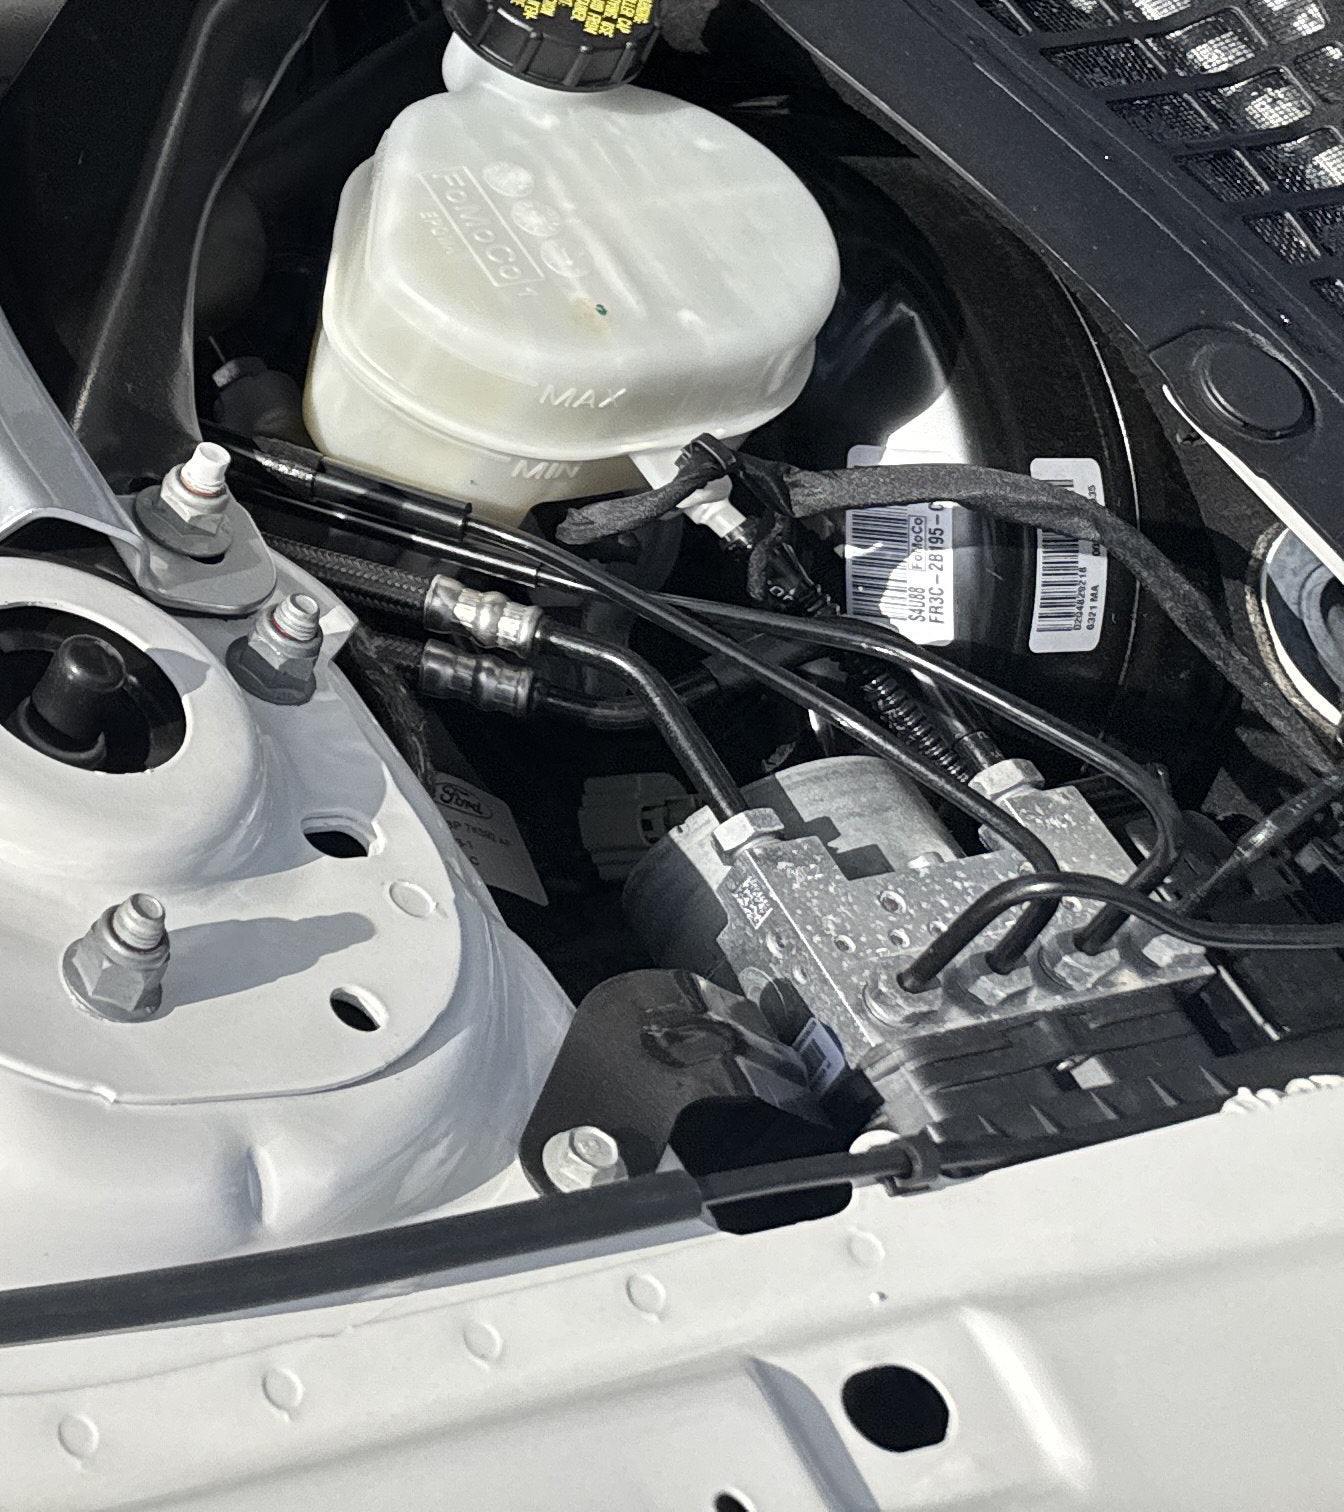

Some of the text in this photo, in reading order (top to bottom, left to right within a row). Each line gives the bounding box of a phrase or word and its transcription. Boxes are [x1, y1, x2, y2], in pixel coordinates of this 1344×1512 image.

[432, 173, 522, 280] FoMoCo
[539, 384, 627, 408] MAX
[512, 459, 583, 480] MIN
[908, 517, 926, 623] S4U88 FoMoCo
[440, 784, 483, 815] Ford
